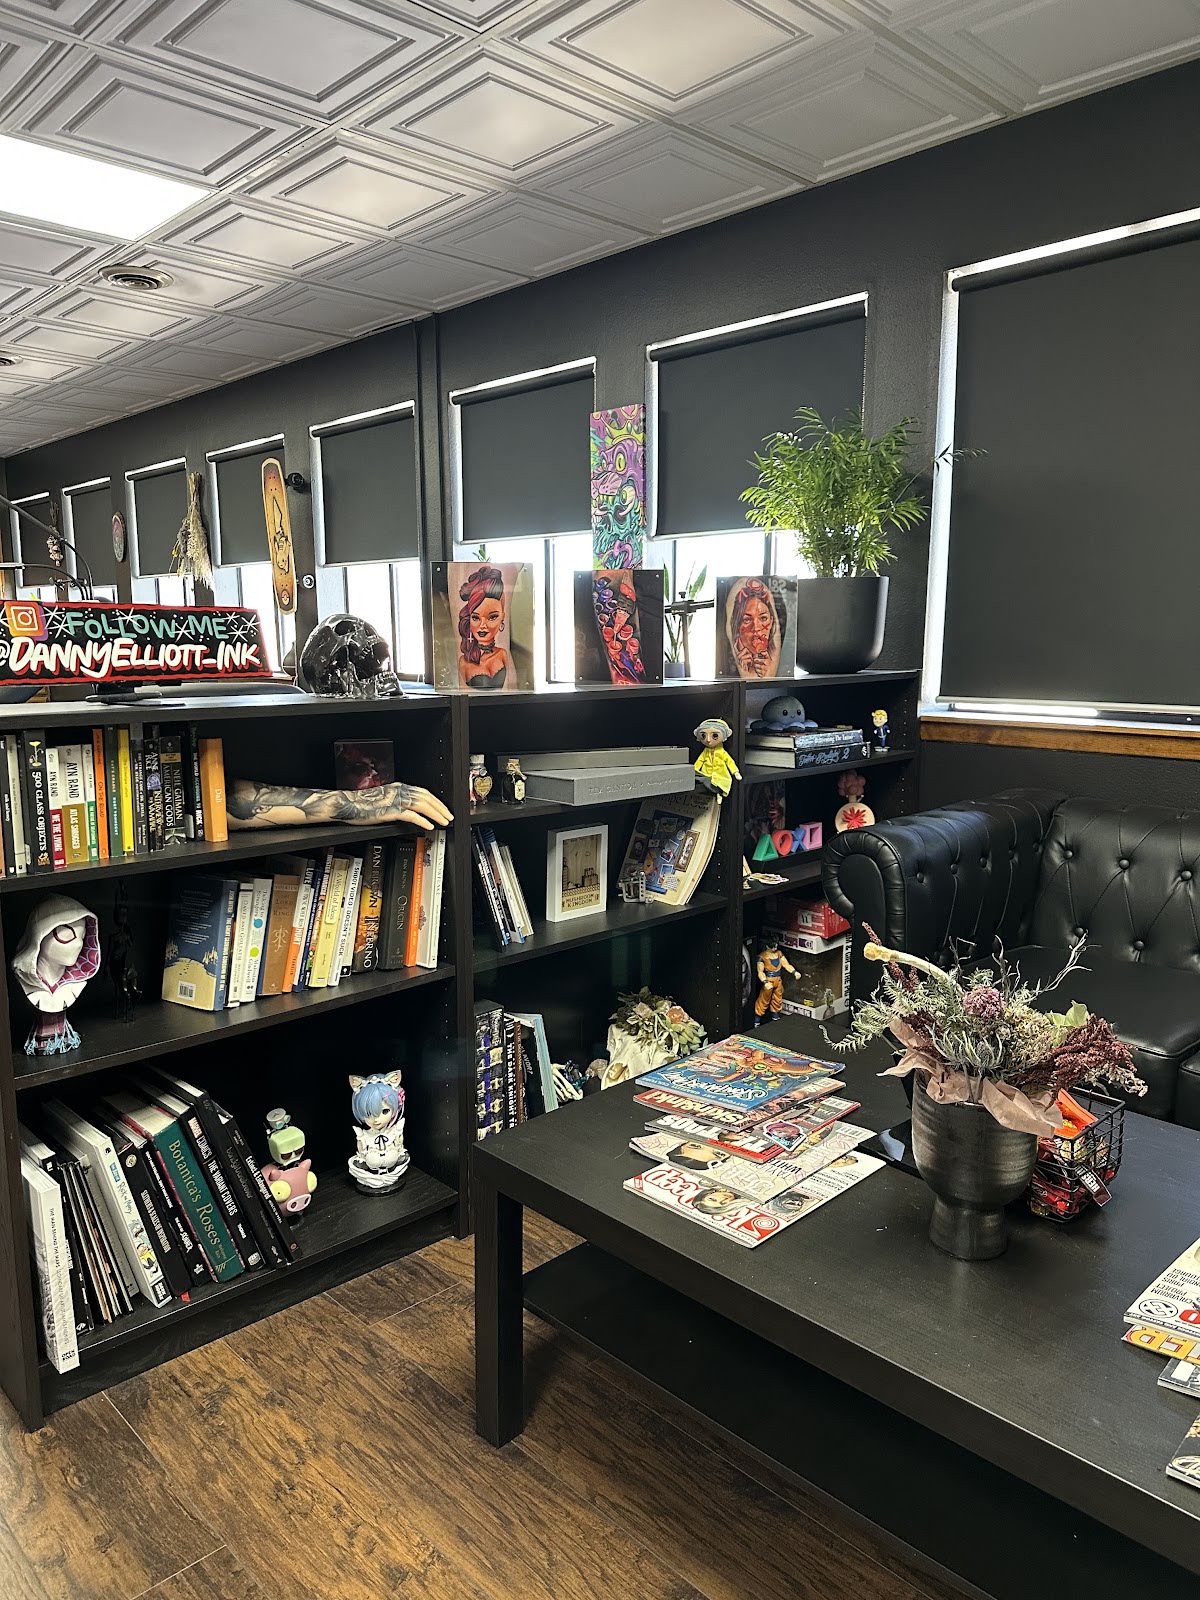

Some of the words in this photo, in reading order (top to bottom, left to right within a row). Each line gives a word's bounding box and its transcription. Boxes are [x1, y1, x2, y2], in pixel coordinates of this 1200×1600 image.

[65, 610, 176, 640] FOLLOW
[189, 614, 230, 640] ME
[66, 761, 78, 777] AYN
[144, 753, 153, 771] RICE
[150, 750, 159, 771] ANNE
[31, 771, 42, 788] 500
[48, 770, 57, 781] AYN
[97, 781, 103, 790] ON
[161, 763, 172, 803] AMERICAN
[172, 768, 181, 787] NEIL
[49, 782, 58, 797] RAND
[67, 778, 79, 798] RAND
[34, 789, 44, 815] GLASS
[173, 787, 184, 820] GAIMAN
[51, 813, 60, 822] WE
[69, 808, 78, 824] ATLAS
[164, 804, 174, 827] GODS
[35, 816, 47, 851] OBJECTS
[52, 822, 61, 833] THE
[70, 824, 80, 849] SHRUGGED
[53, 833, 62, 851] LIVING
[371, 844, 383, 868] DAN
[303, 866, 314, 885] LOVE
[350, 866, 360, 885] SHOOT
[333, 879, 342, 897] World
[347, 886, 356, 906] VIDEO
[368, 869, 380, 908] BROWN
[564, 893, 594, 903] MUSHROOM
[259, 889, 268, 911] Talking
[566, 897, 593, 908] KINGDOM
[329, 904, 338, 921] Ideas
[395, 894, 408, 930] ORIGIN
[341, 909, 352, 937] DOESN'T
[237, 931, 245, 961] GOLIATH
[292, 927, 304, 946] HURT
[360, 917, 379, 968] INFERNO
[337, 937, 346, 957] SUCK
[245, 958, 253, 983] Gladwell
[186, 1116, 204, 1138] MARVEL
[194, 1134, 213, 1159] COMICS
[206, 1159, 219, 1173] THE
[210, 1169, 229, 1193] VARIANT
[244, 1154, 259, 1173] Extinct
[253, 1174, 272, 1201] Endangered
[114, 1180, 129, 1198] Rick
[166, 1138, 206, 1203] Botanica's
[196, 1203, 221, 1246] Roses
[642, 1167, 703, 1211] Deep
[219, 1190, 239, 1216] COVERS
[236, 1223, 247, 1239] THOMAS
[1154, 1282, 1187, 1296] PROJECT
[1160, 1275, 1185, 1287] PARIS
[1149, 1286, 1193, 1305] CALVARIUM
[61, 1349, 76, 1358] OPEN
